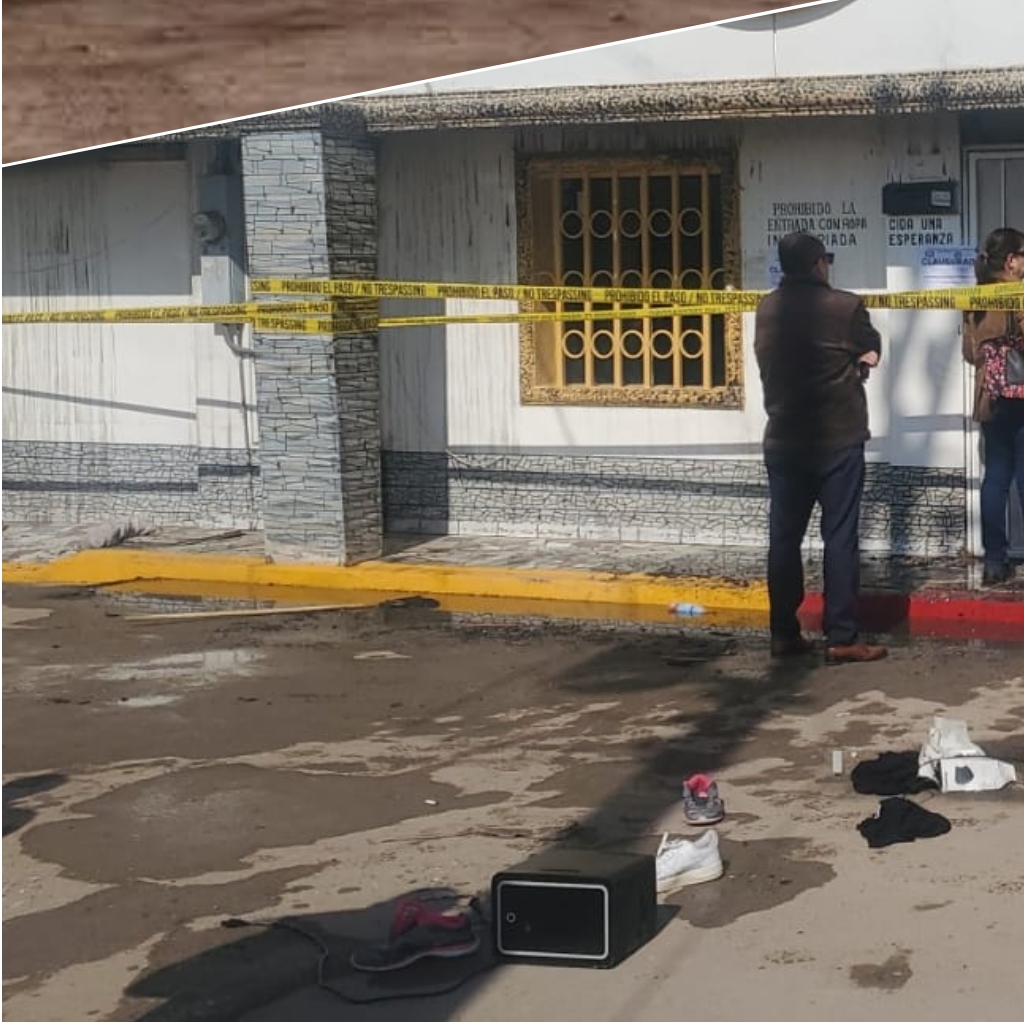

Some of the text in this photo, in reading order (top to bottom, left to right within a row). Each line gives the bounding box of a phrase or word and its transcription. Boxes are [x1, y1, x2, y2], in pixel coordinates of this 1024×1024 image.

[772, 201, 856, 216] PROHIBIDO LA
[767, 218, 815, 232] ENTRADA
[818, 217, 841, 231] CON
[889, 218, 942, 231] CIDA UNA
[889, 232, 953, 246] ESPERANZA
[322, 282, 331, 294] EL
[333, 282, 354, 295] PASO
[652, 291, 662, 303] EL
[664, 291, 685, 304] PASO
[878, 297, 890, 308] NO
[894, 297, 955, 309] TRESPASSING
[969, 298, 1020, 310] PROHIBIDO
